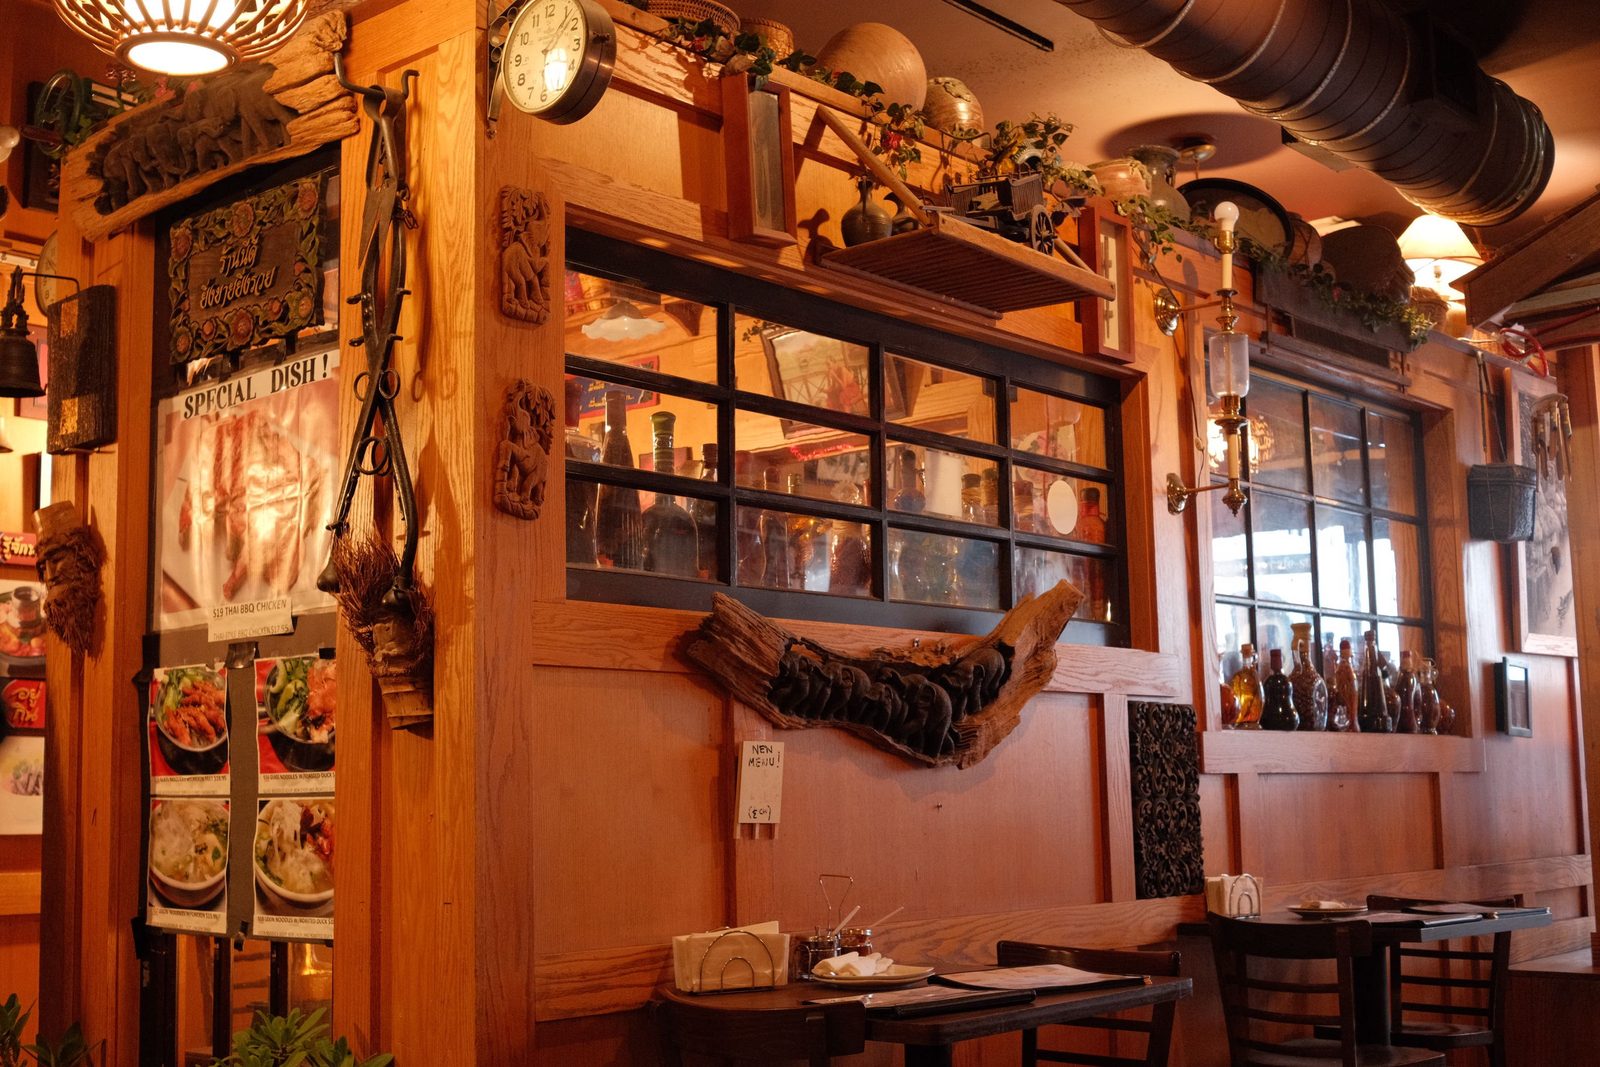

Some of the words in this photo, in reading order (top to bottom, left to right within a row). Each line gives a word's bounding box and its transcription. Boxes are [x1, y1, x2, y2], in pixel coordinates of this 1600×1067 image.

[545, 4, 555, 18] 12
[531, 14, 540, 28] 11
[570, 18, 578, 31] 2
[520, 32, 529, 46] 10
[573, 38, 581, 52] 3
[514, 54, 522, 67] 9
[568, 59, 575, 72] 4
[517, 73, 526, 86] 8
[528, 86, 535, 100] 7
[184, 376, 257, 420] SPECIAL
[270, 357, 316, 394] DISH
[225, 606, 240, 616] THAI
[240, 603, 255, 614] BBQ
[256, 599, 288, 612] CHICKEN
